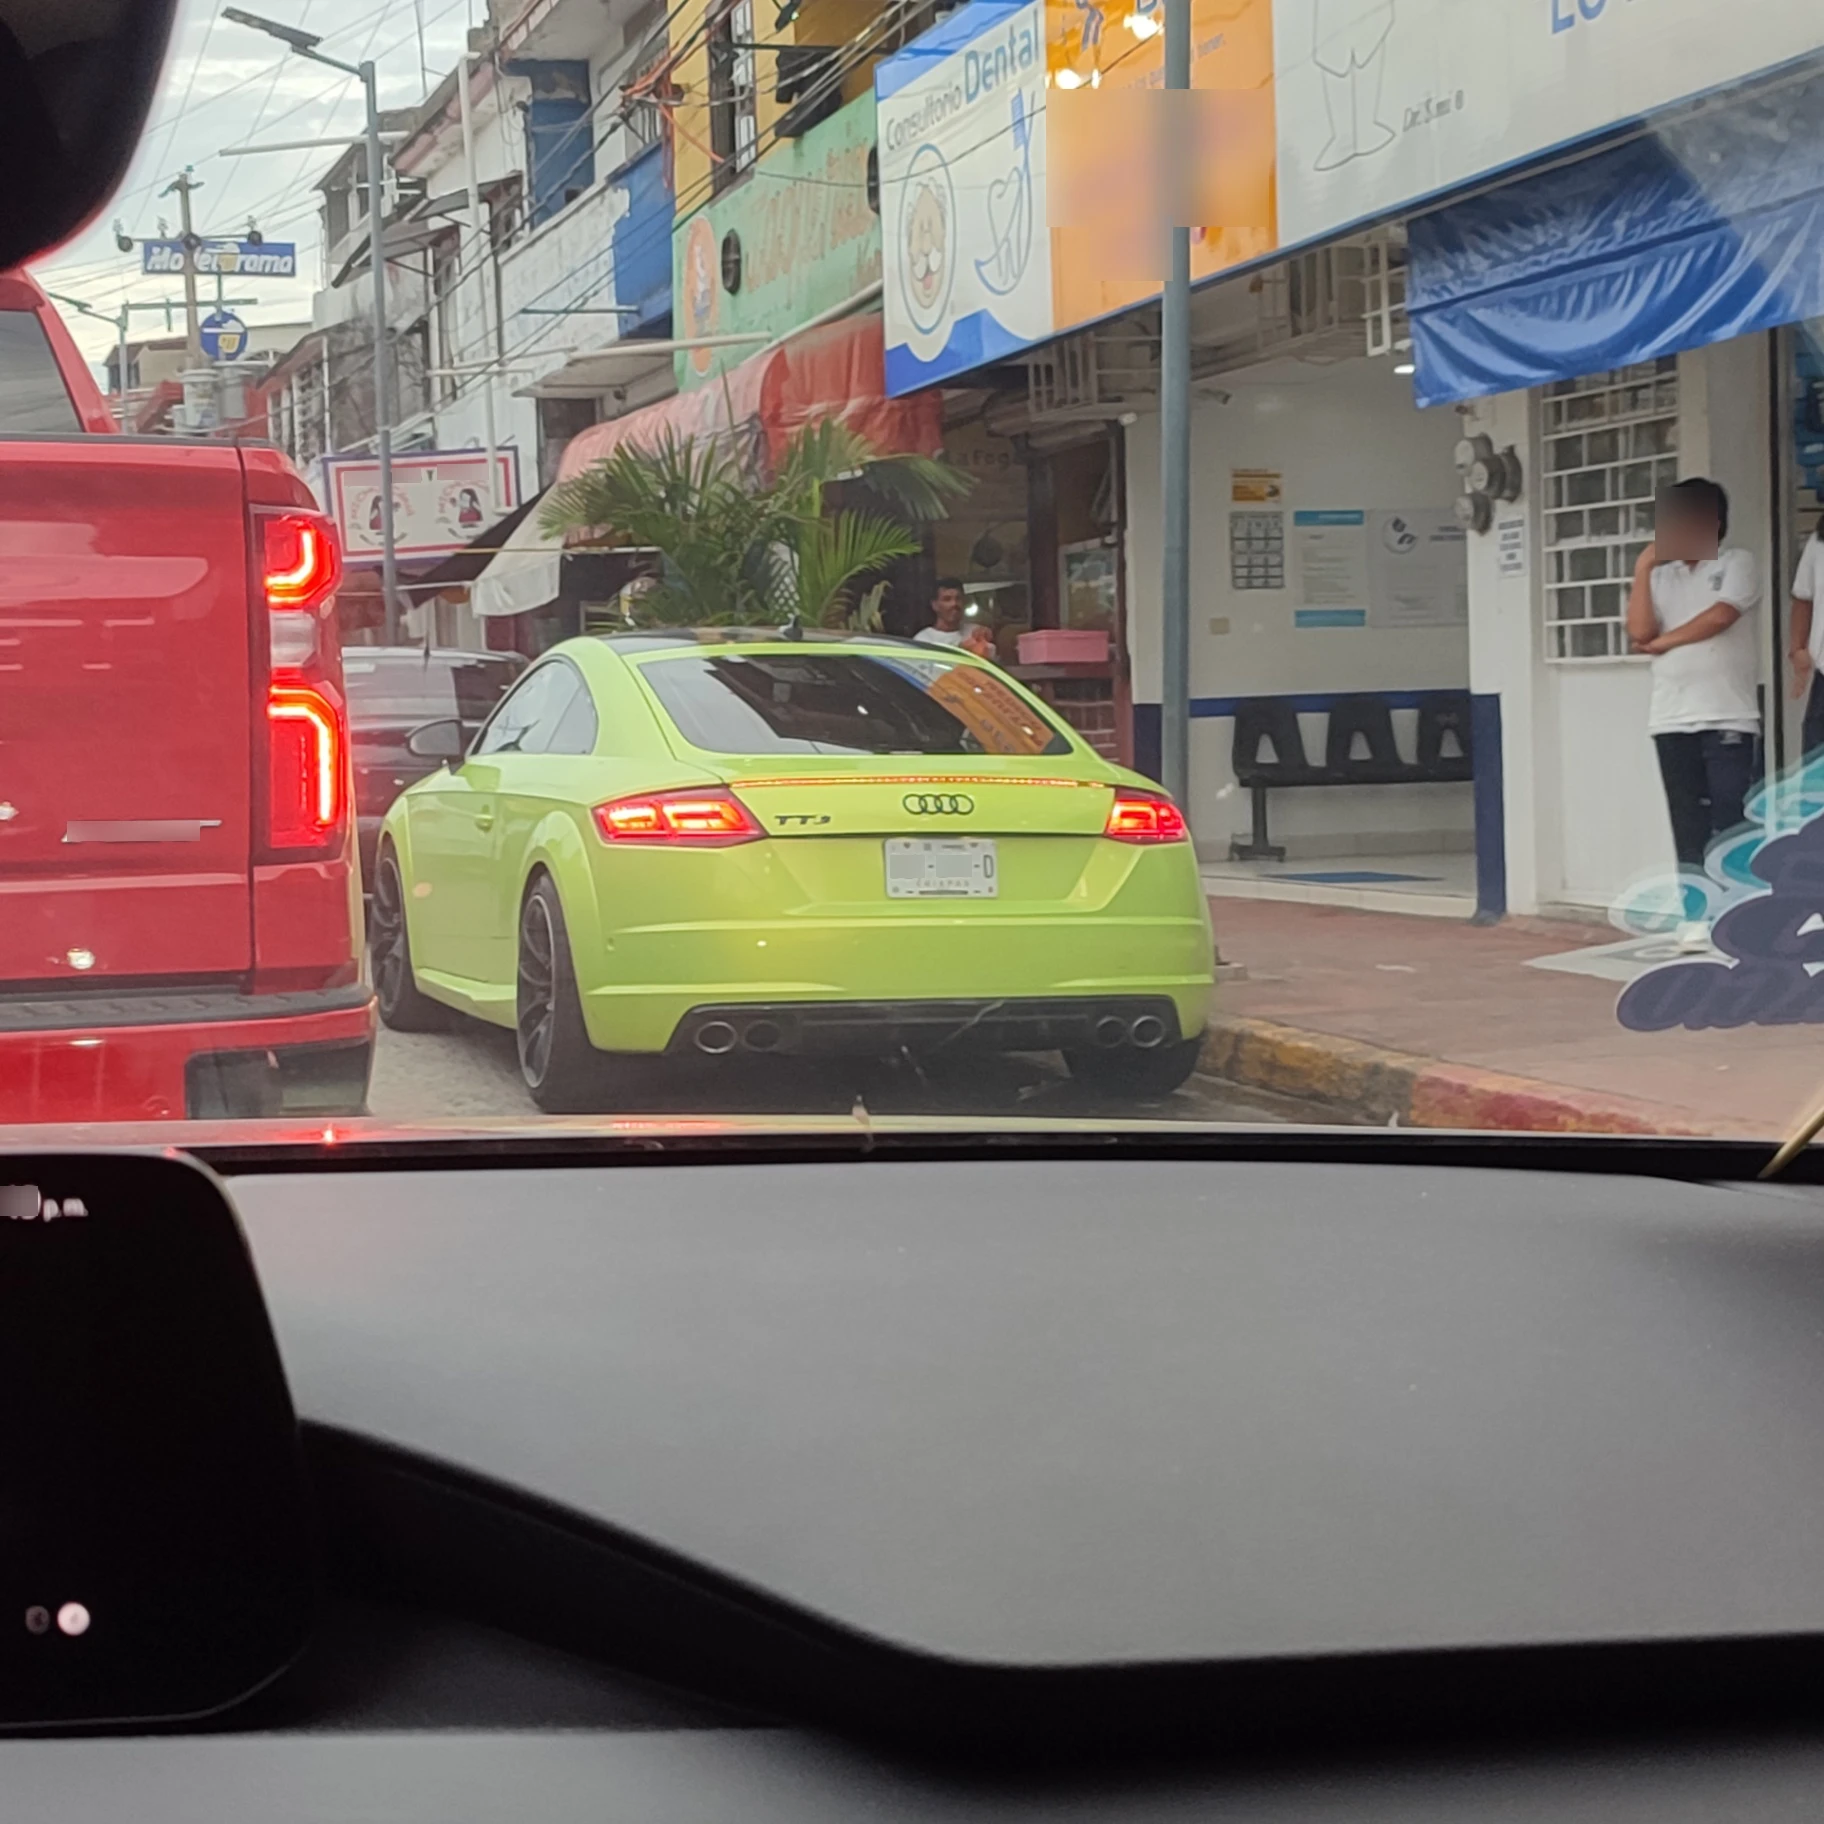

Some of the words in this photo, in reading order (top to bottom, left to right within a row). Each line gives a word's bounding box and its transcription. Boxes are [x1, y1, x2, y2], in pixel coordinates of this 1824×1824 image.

[886, 84, 962, 150] Consultorio
[964, 8, 1039, 104] Dental
[146, 245, 294, 274] Moelrama
